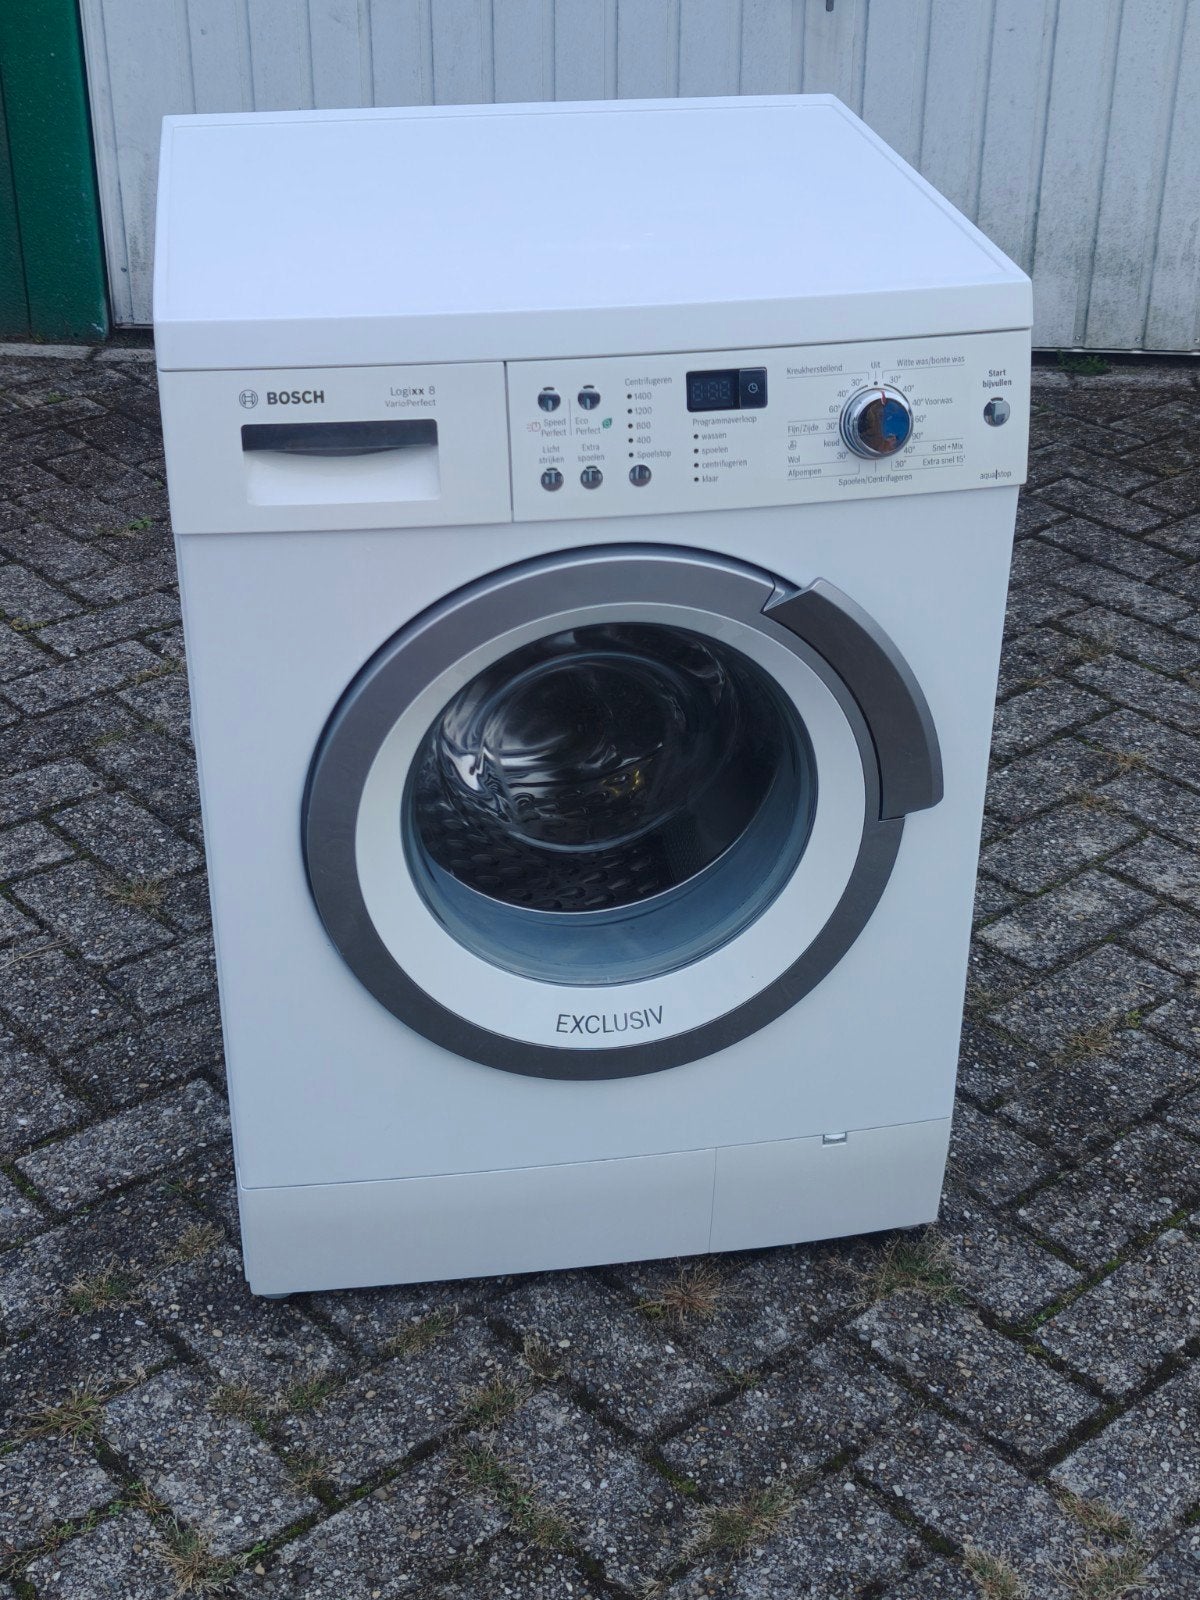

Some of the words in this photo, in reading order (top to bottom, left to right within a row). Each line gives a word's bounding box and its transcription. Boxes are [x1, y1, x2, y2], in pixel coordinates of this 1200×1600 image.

[988, 369, 1006, 377] Start
[625, 377, 672, 387] Centrifugeren
[982, 379, 1012, 388] bijvullen
[390, 386, 425, 398] Logixx
[428, 386, 436, 395] 8
[634, 392, 652, 400] 1400
[266, 390, 325, 405] BOSCH
[925, 397, 953, 405] Voorwas
[384, 399, 436, 408] VarioPerfect
[635, 407, 652, 415] 1200
[544, 418, 566, 427] Speed
[692, 415, 757, 427] Programmaverloop
[541, 428, 567, 437] Perfect
[576, 427, 600, 435] Perfect
[701, 432, 727, 440] wassen
[824, 438, 840, 447] koud
[582, 444, 600, 452] Extra
[701, 446, 728, 455] spoelen
[578, 454, 605, 463] spoelen
[637, 450, 671, 460] Spoelstop
[788, 455, 800, 463] Wol
[539, 456, 565, 464] strijken
[702, 459, 747, 469] centrifugeren
[923, 458, 939, 466] Extra
[942, 456, 954, 464] snel
[788, 468, 821, 477] Afpompen
[702, 475, 719, 483] klaar
[556, 1005, 662, 1034] EXCLUSIV
